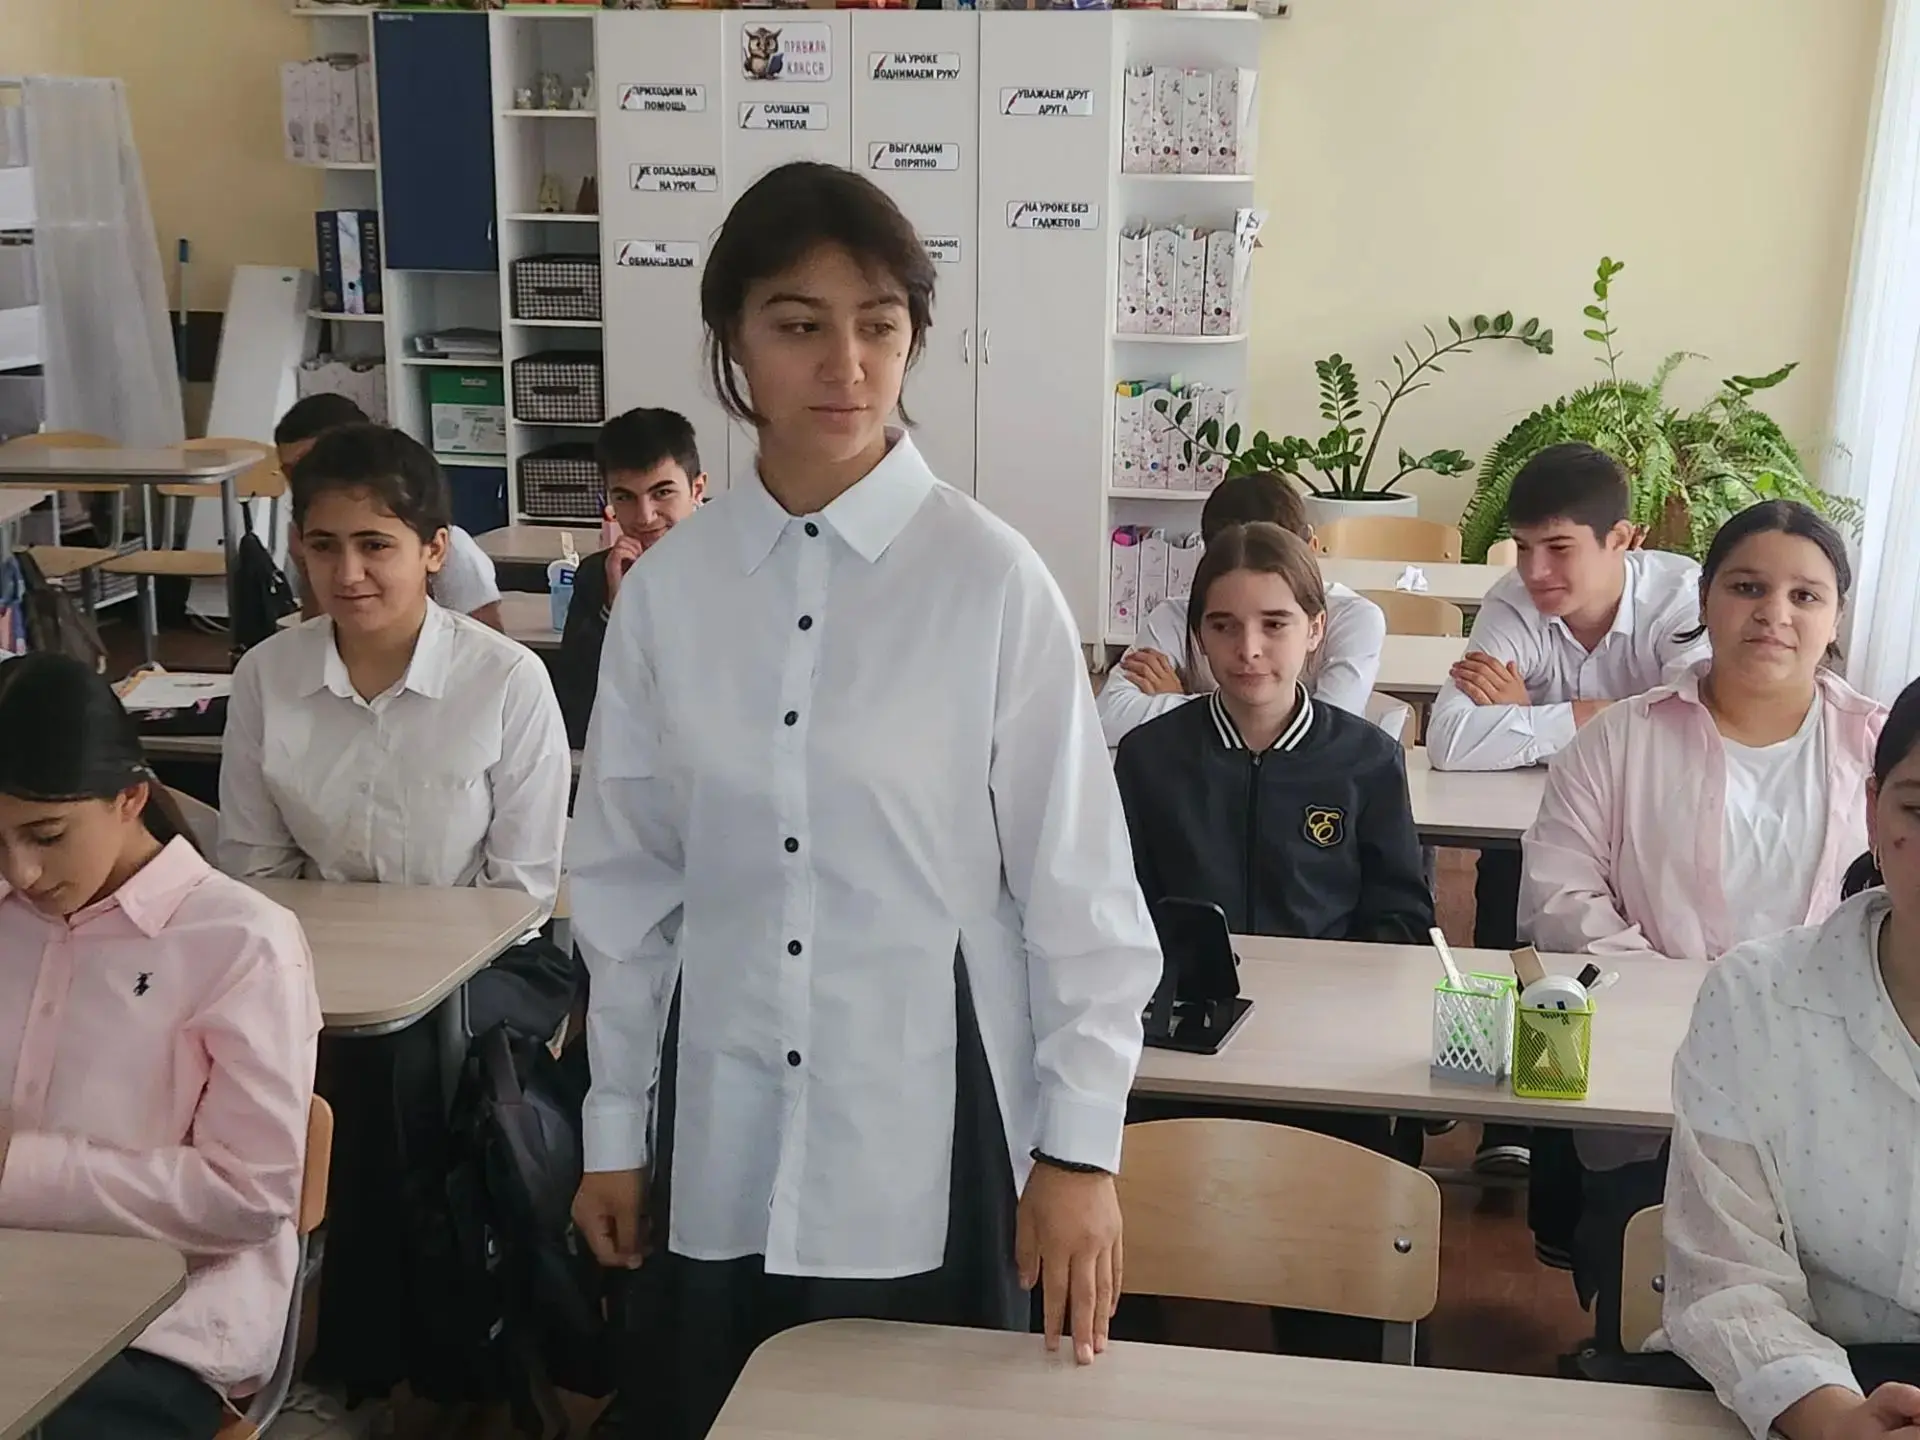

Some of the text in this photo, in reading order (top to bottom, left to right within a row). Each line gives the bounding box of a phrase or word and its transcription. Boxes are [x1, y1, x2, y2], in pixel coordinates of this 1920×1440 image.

[784, 40, 826, 54] ПРАВИЛА
[894, 54, 938, 64] НА УРОКЕ
[787, 61, 824, 75] КЛАССА
[936, 69, 960, 79] РУКУ
[685, 87, 698, 96] НА
[1018, 89, 1089, 100] УВАЖАЕМ ДРУГ
[644, 101, 686, 112] ПОМОЩЬ
[764, 104, 809, 114] СЛУШАЕМ
[1038, 104, 1068, 115] ДРУГА
[767, 119, 807, 129] УЧИТЕЛЯ
[889, 143, 943, 154] ВЫГЛЯДИМ
[894, 158, 937, 168] ОПРЯТНО
[653, 166, 716, 176] ОПАЗДЫВАЕМ
[659, 181, 697, 191] НА УРОК
[1025, 203, 1088, 213] НА УРОКЕ БЕЗ
[1032, 218, 1080, 229] ГАДЖЕТОВ
[655, 243, 666, 253] НЕ
[628, 257, 694, 267] ОБМАНЫВАЕМ
